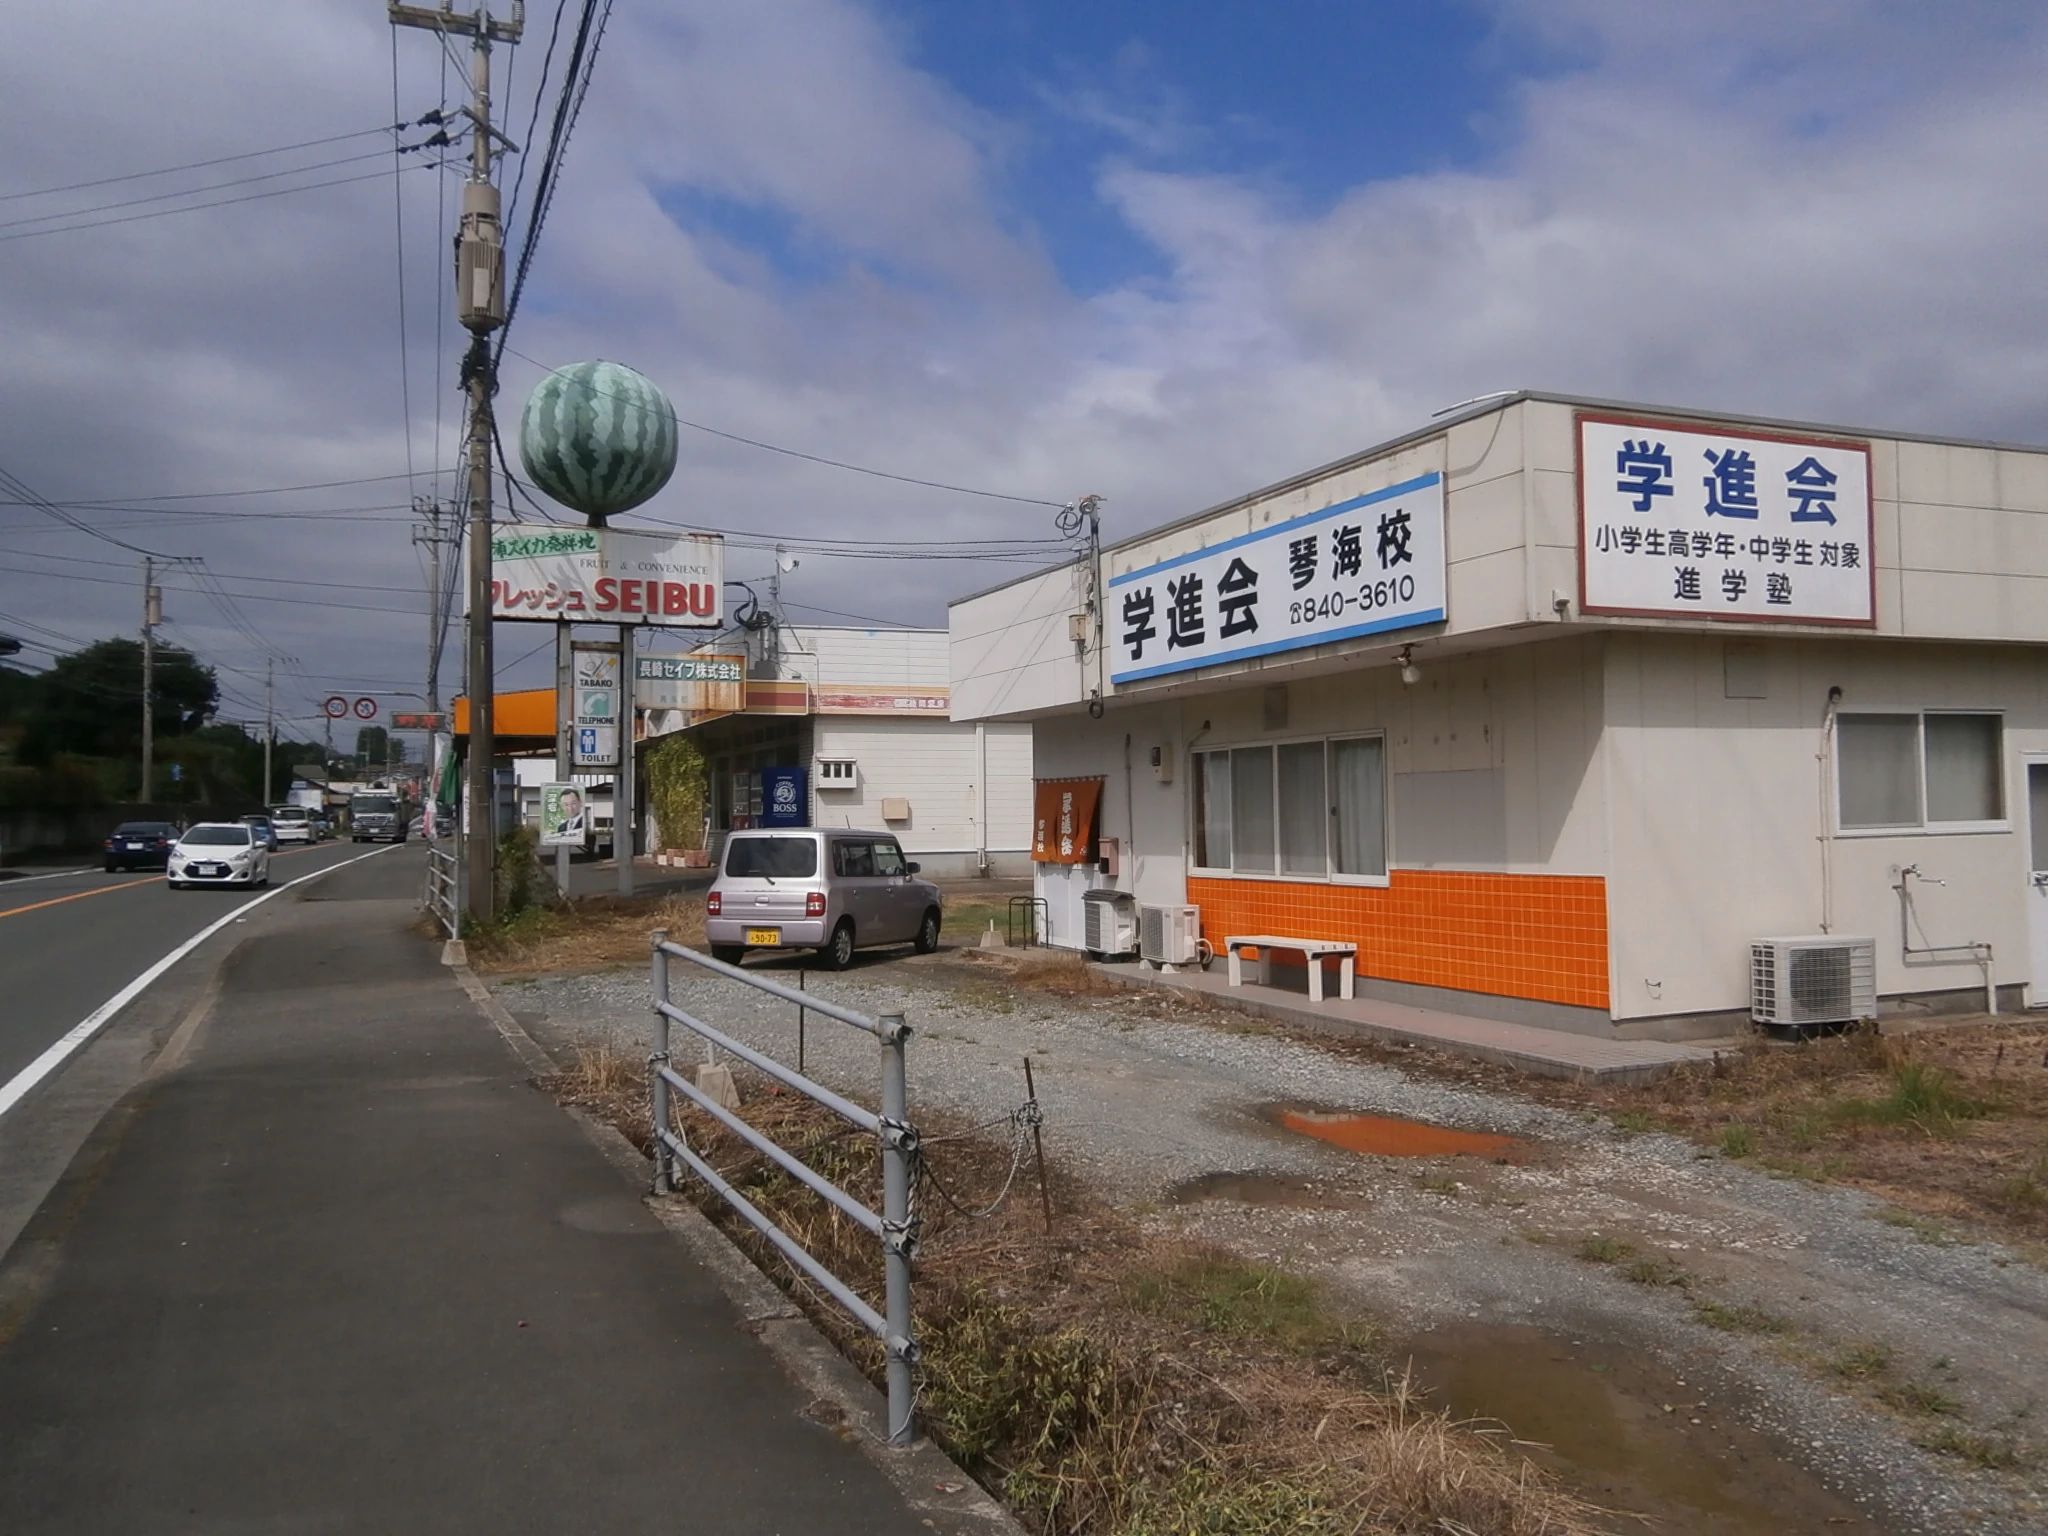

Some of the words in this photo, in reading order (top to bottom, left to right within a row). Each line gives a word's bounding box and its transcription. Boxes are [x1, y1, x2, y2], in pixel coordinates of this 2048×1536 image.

[1617, 439, 1838, 526] 学進会
[1289, 508, 1413, 591] 琴海校
[580, 559, 610, 570] FRUIT
[638, 561, 709, 576] CONVENIENCE
[594, 577, 715, 617] SEIBU
[1303, 574, 1416, 624] 840-3610
[1674, 566, 1793, 605] 進学塾
[1122, 556, 1259, 661] 学進会
[580, 679, 613, 688] TABAKO
[640, 661, 741, 680] 長崎セイブ株式会社
[578, 716, 615, 725] TELEPHONE
[581, 755, 612, 763] TOILET
[773, 804, 797, 812] BOSS
